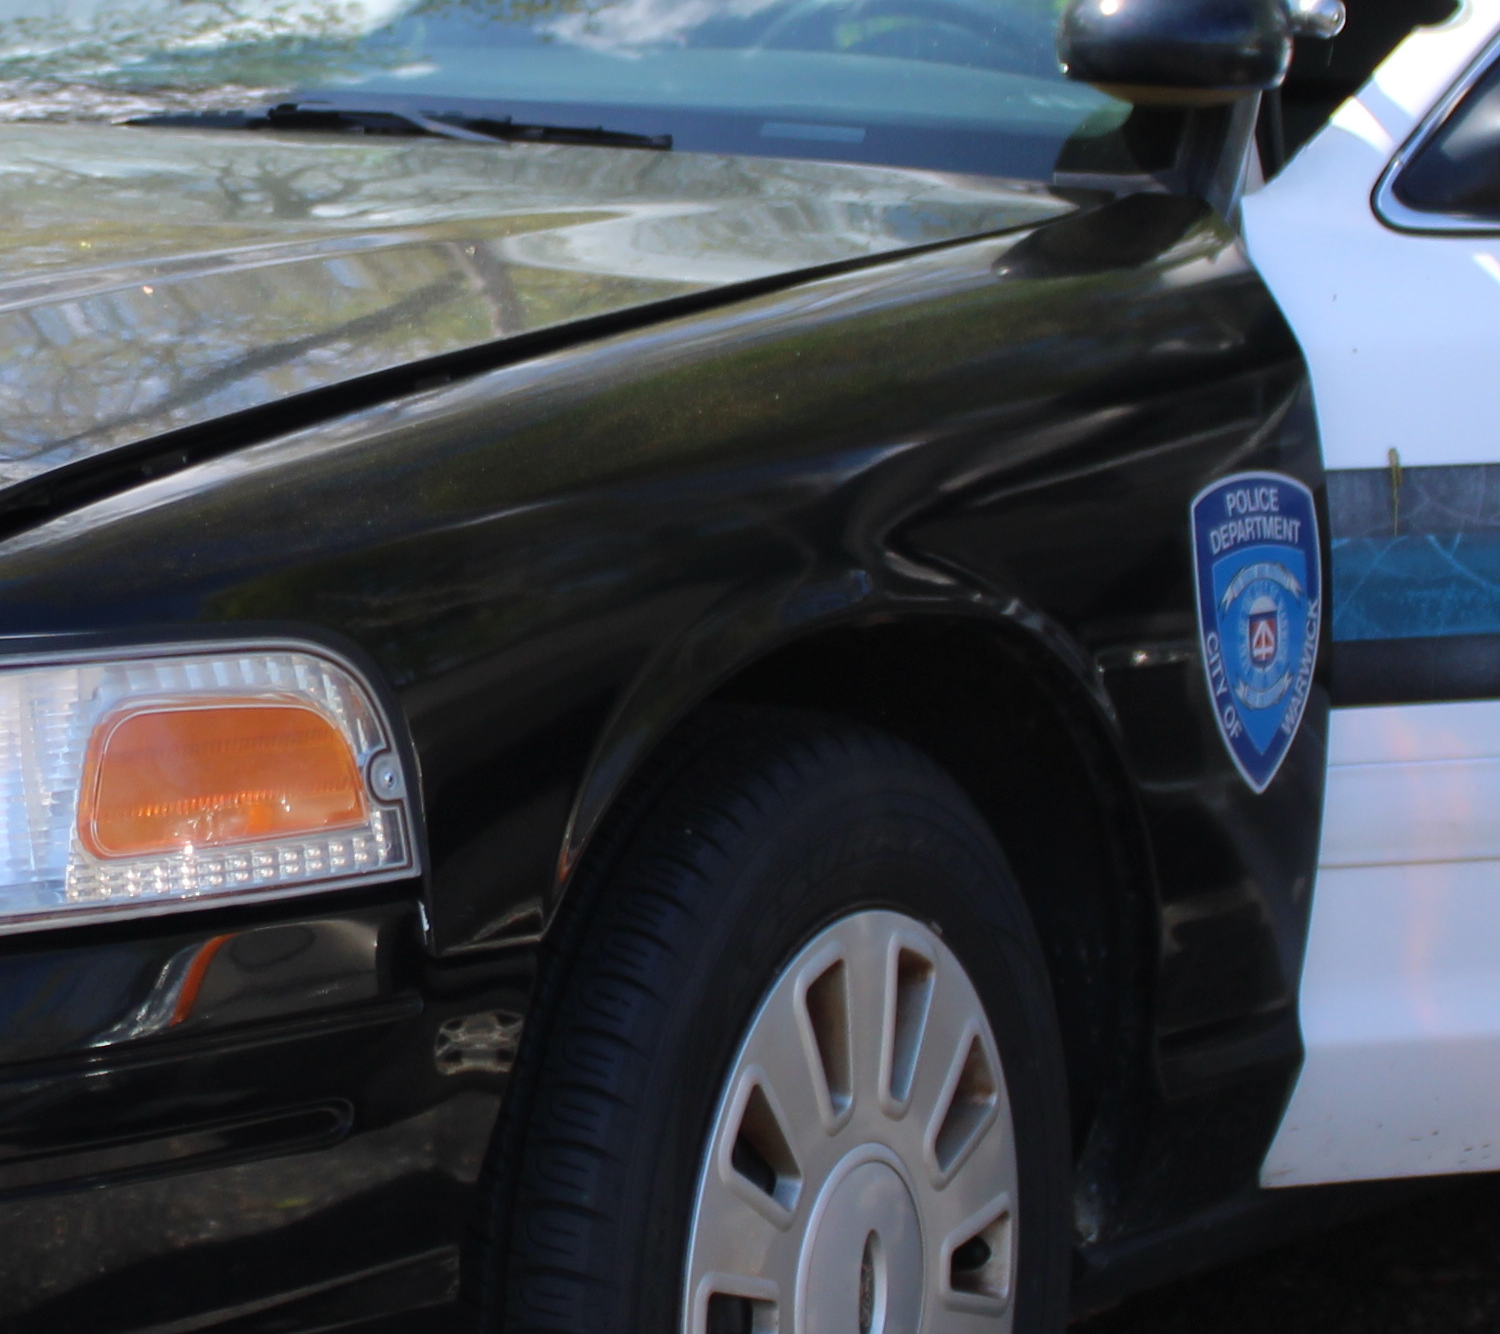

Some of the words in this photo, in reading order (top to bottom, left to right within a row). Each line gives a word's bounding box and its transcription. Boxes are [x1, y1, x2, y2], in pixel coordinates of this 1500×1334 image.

[1209, 515, 1301, 555] DEPARTMENT
[1226, 487, 1280, 517] POLICE
[1206, 631, 1229, 697] CITY
[1223, 705, 1243, 738] OF
[1280, 598, 1319, 736] WARWICK
